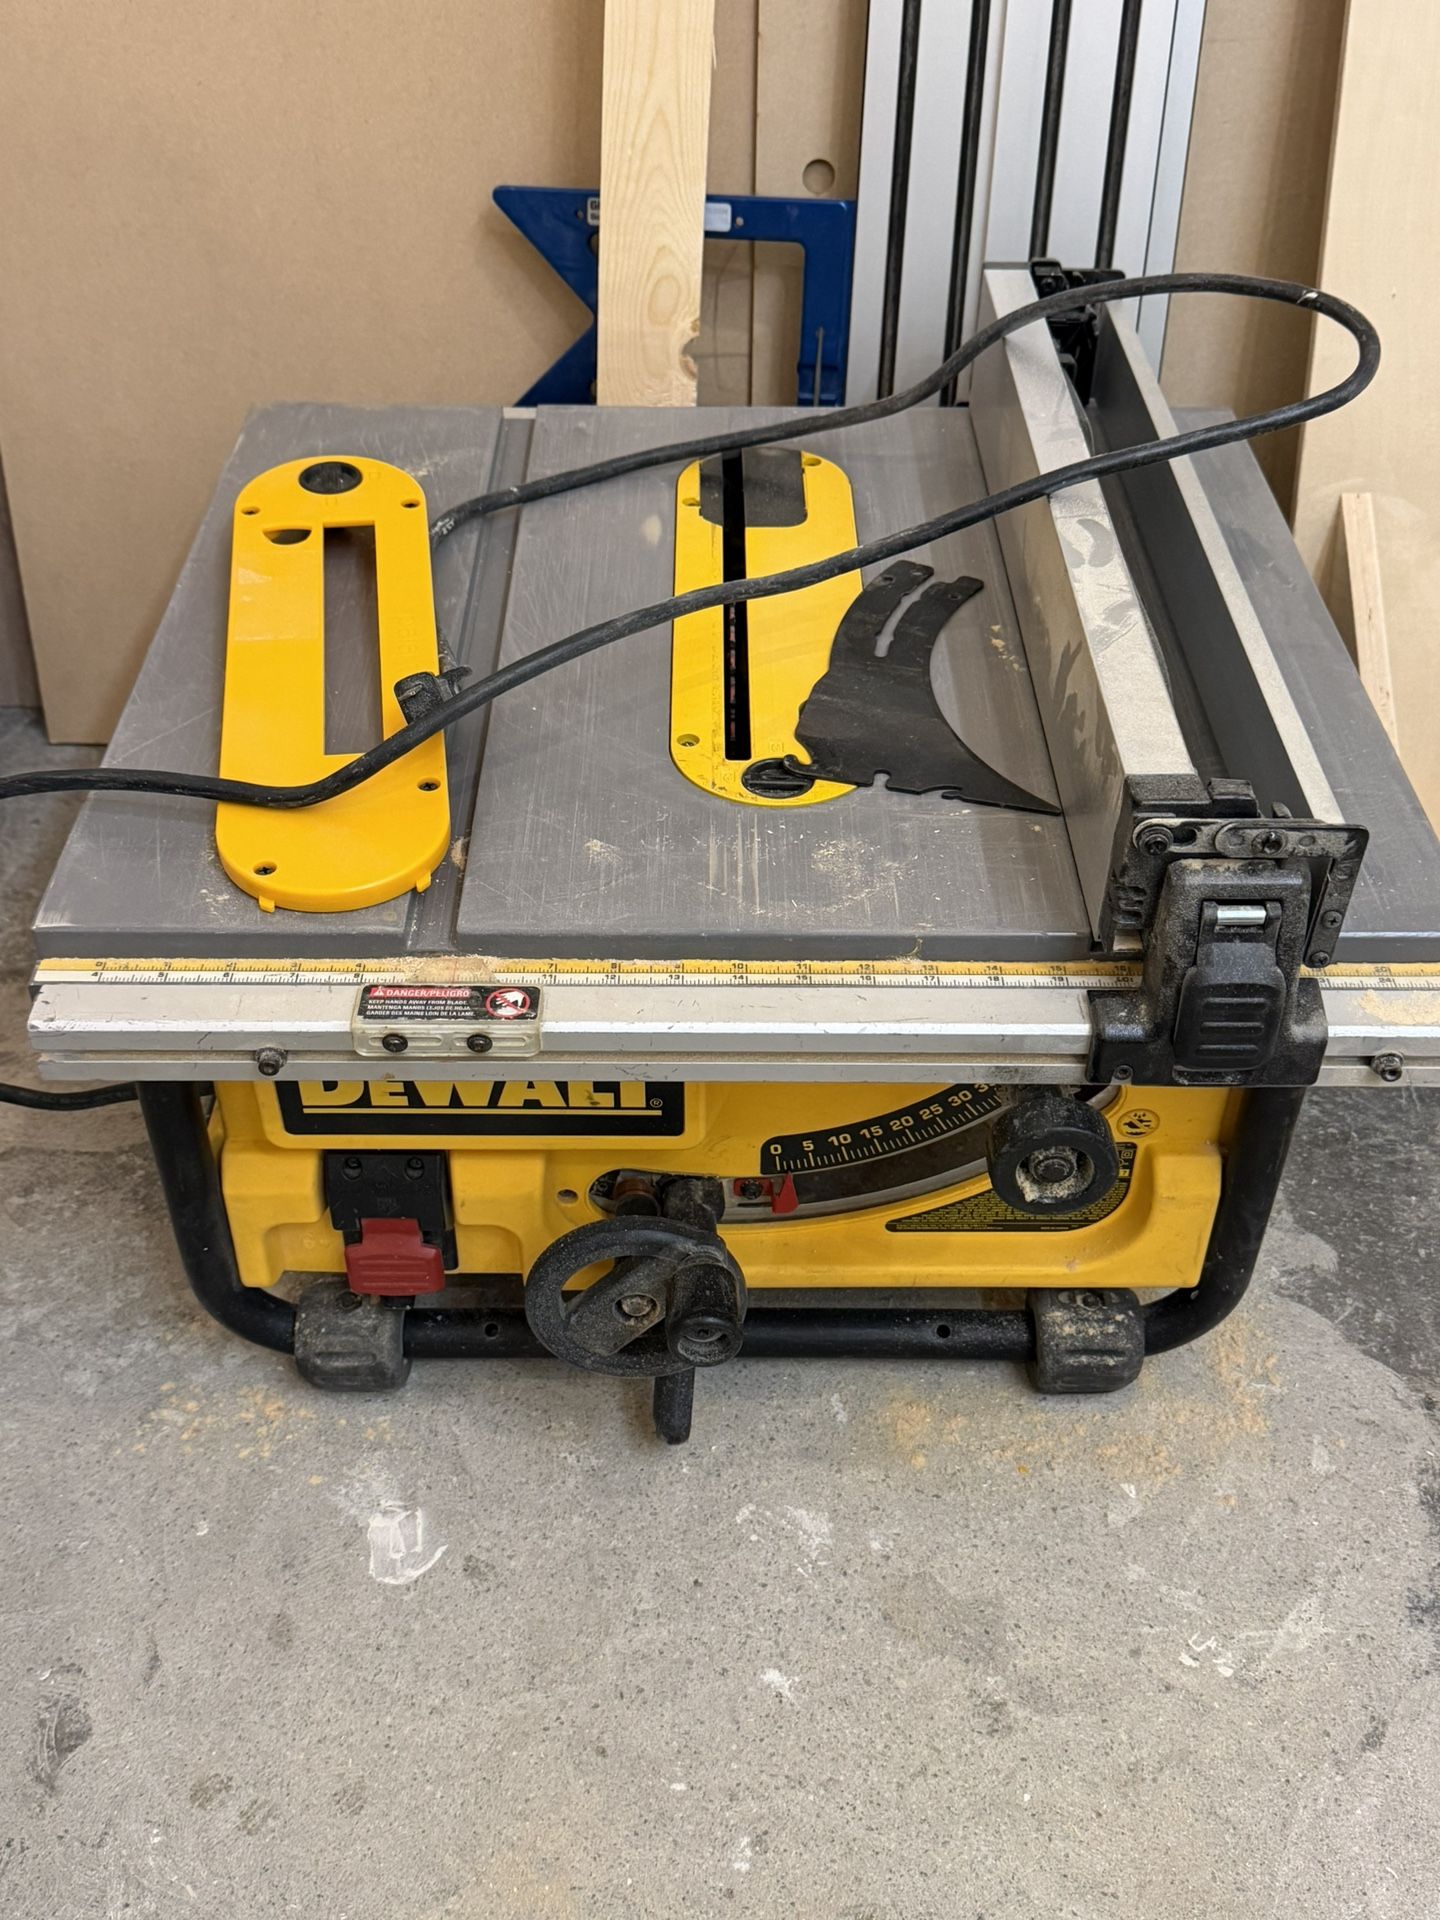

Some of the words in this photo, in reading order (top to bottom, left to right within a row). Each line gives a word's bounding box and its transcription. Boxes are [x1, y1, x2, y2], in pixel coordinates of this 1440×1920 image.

[386, 989, 470, 997] DANGER/PELIGRO
[769, 1143, 782, 1155] 0
[802, 1139, 815, 1152] 5
[827, 1132, 852, 1147] 10
[859, 1124, 884, 1139] 15
[889, 1115, 914, 1132] 20
[918, 1102, 944, 1121] 25
[947, 1089, 973, 1107] 30
